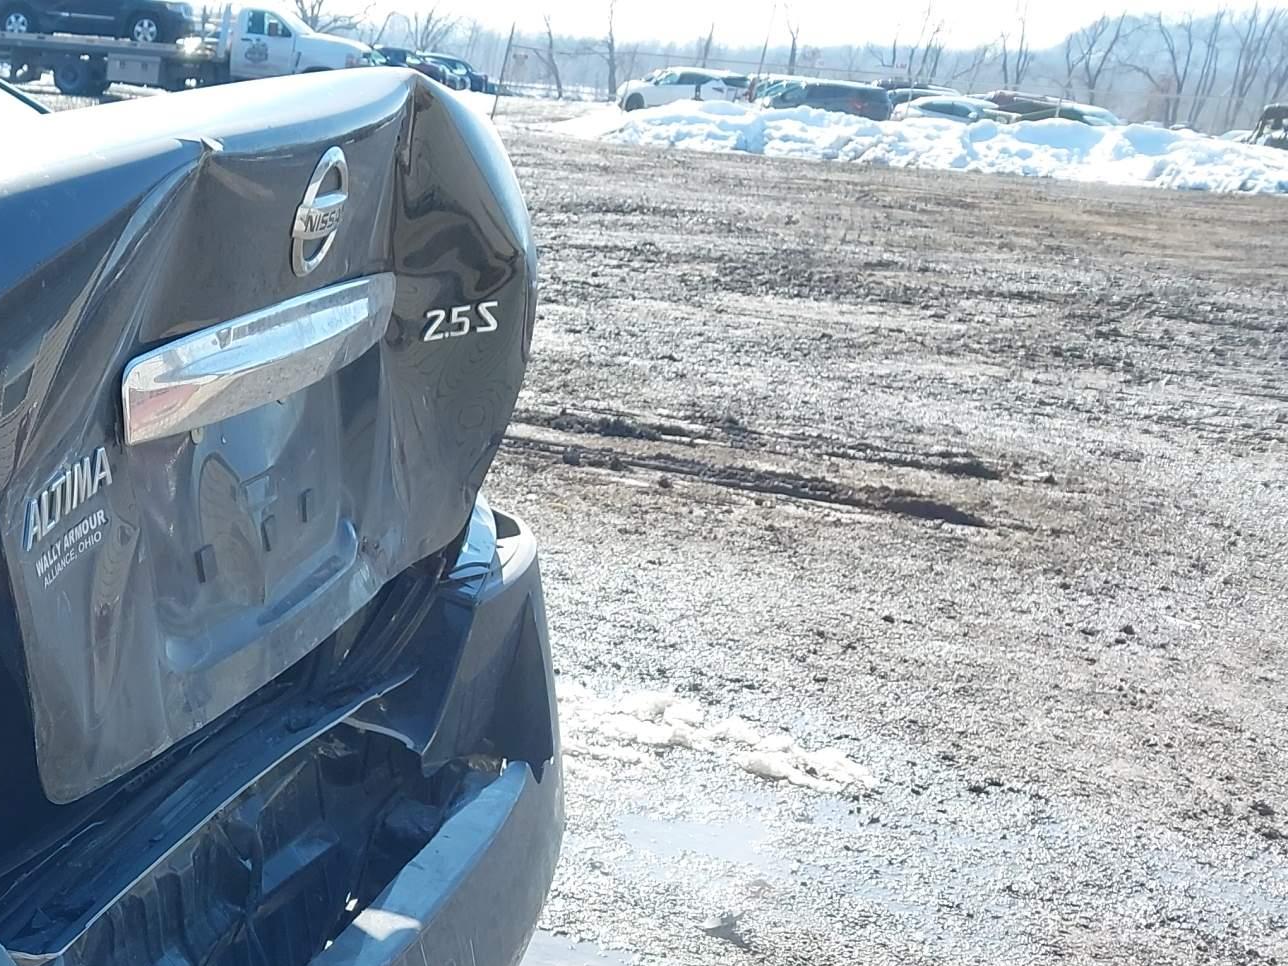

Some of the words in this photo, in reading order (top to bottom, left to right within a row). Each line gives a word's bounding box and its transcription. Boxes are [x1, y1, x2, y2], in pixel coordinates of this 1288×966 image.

[476, 301, 498, 332] S
[23, 447, 113, 551] ALTIMA
[35, 540, 61, 577] WALLY
[63, 509, 107, 551] ARMOUR
[44, 548, 78, 589] ALLIANCE,
[78, 531, 102, 553] OHIO
